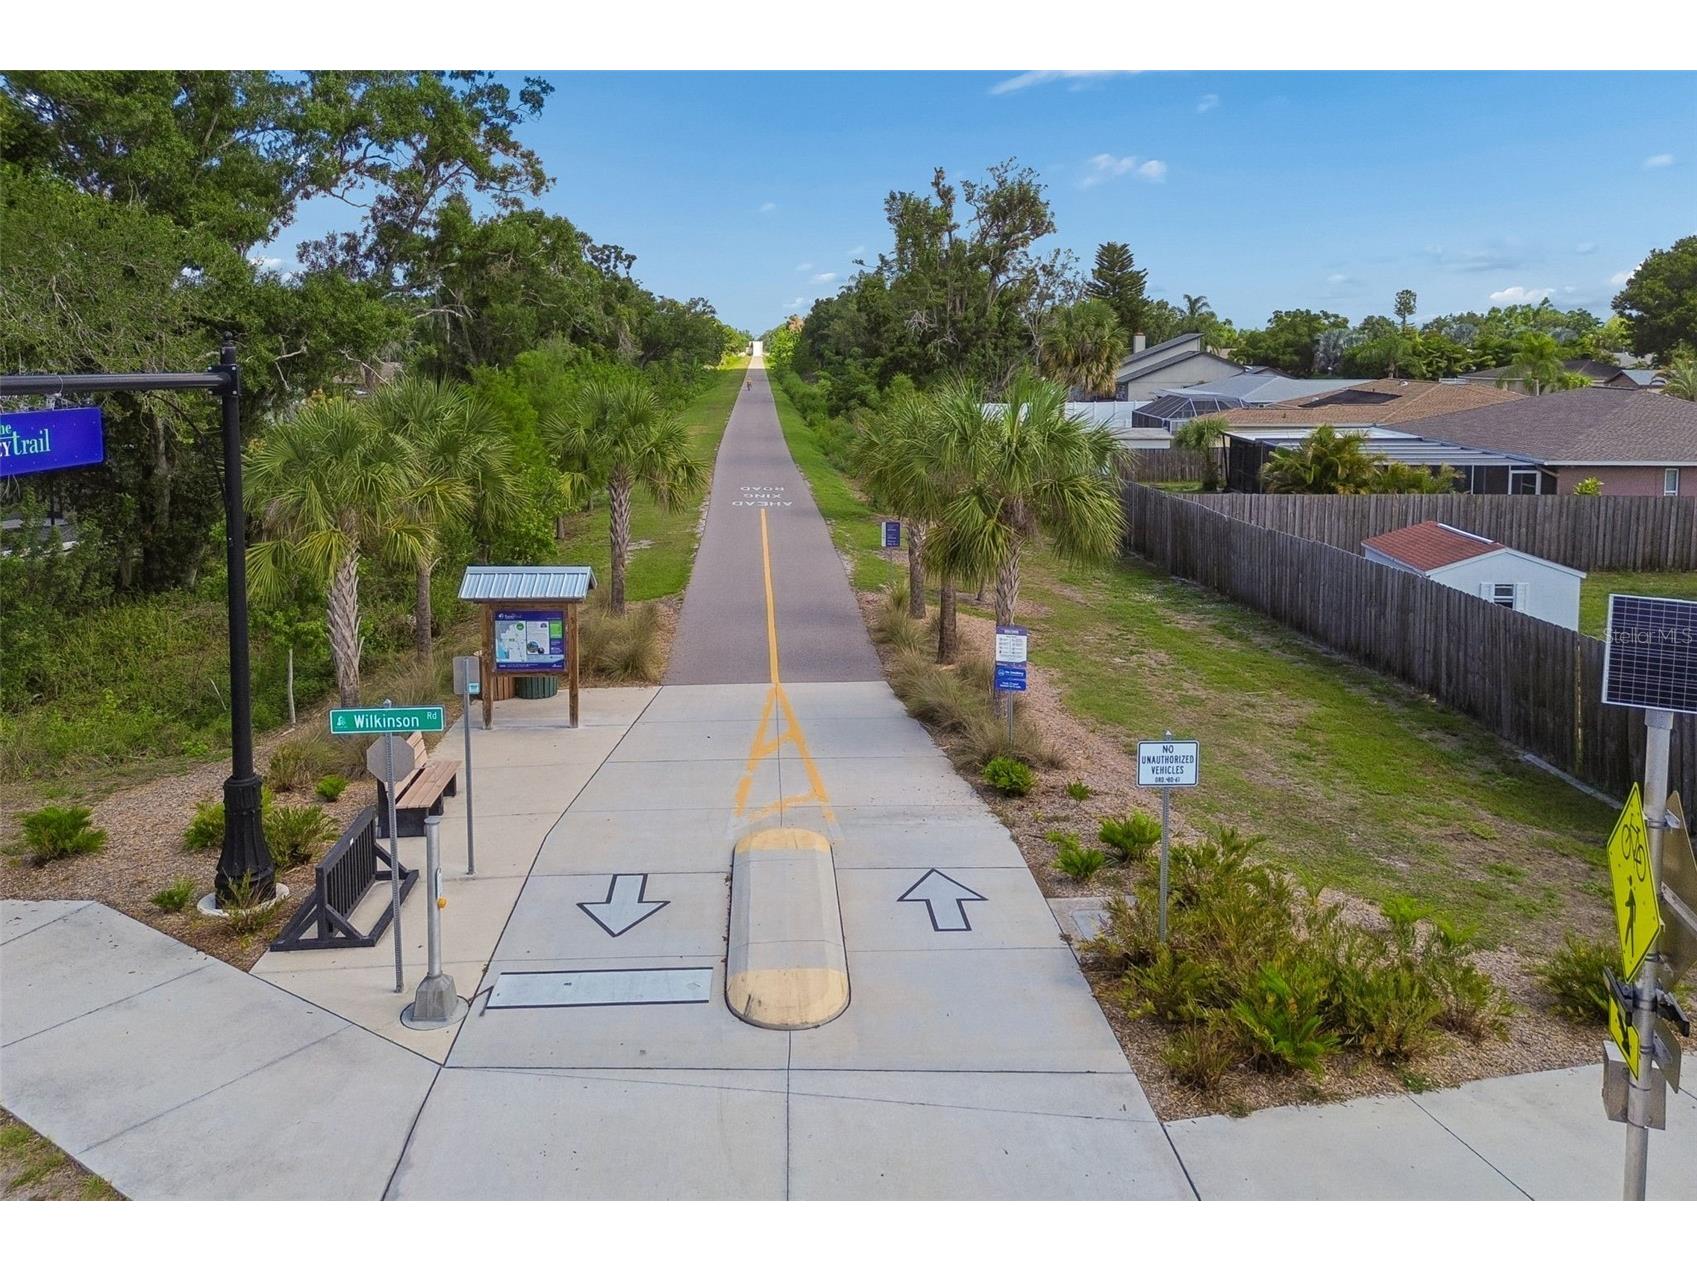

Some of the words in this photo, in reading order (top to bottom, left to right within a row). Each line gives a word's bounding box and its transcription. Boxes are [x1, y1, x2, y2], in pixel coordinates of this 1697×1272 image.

[354, 713, 419, 729] Wilkinson
[426, 711, 437, 720] Rd
[1162, 744, 1174, 753] NO
[1141, 755, 1195, 764] UNAUTHORIZED
[1151, 765, 1184, 775] VEHICLES
